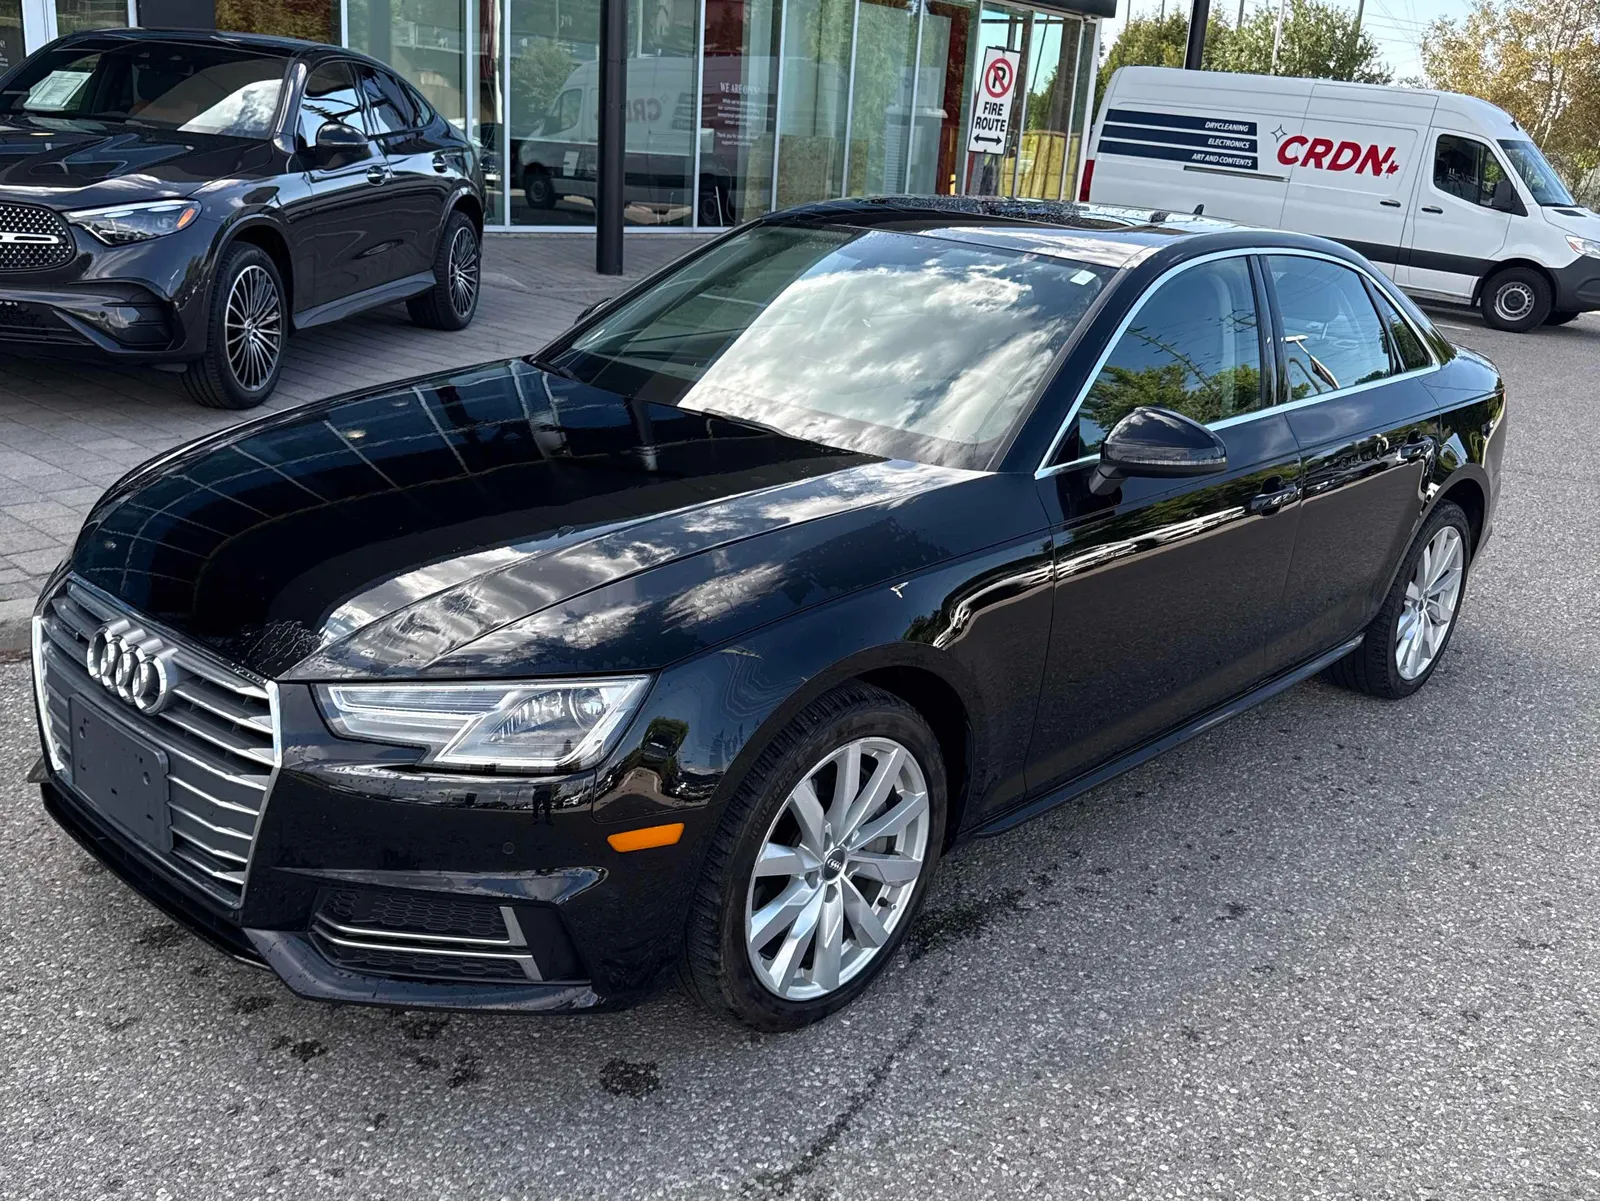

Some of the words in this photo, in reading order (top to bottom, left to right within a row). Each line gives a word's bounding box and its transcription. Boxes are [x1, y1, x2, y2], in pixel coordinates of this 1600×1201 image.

[983, 102, 1004, 116] FIRE
[975, 117, 1006, 132] ROUTE
[1204, 121, 1249, 132] DRYCLEANING
[1207, 137, 1250, 149] ELECTRONICS
[1191, 153, 1205, 161] ART
[1204, 154, 1219, 163] AND
[1219, 156, 1253, 167] CONTENTS
[1277, 135, 1397, 177] CRDN
